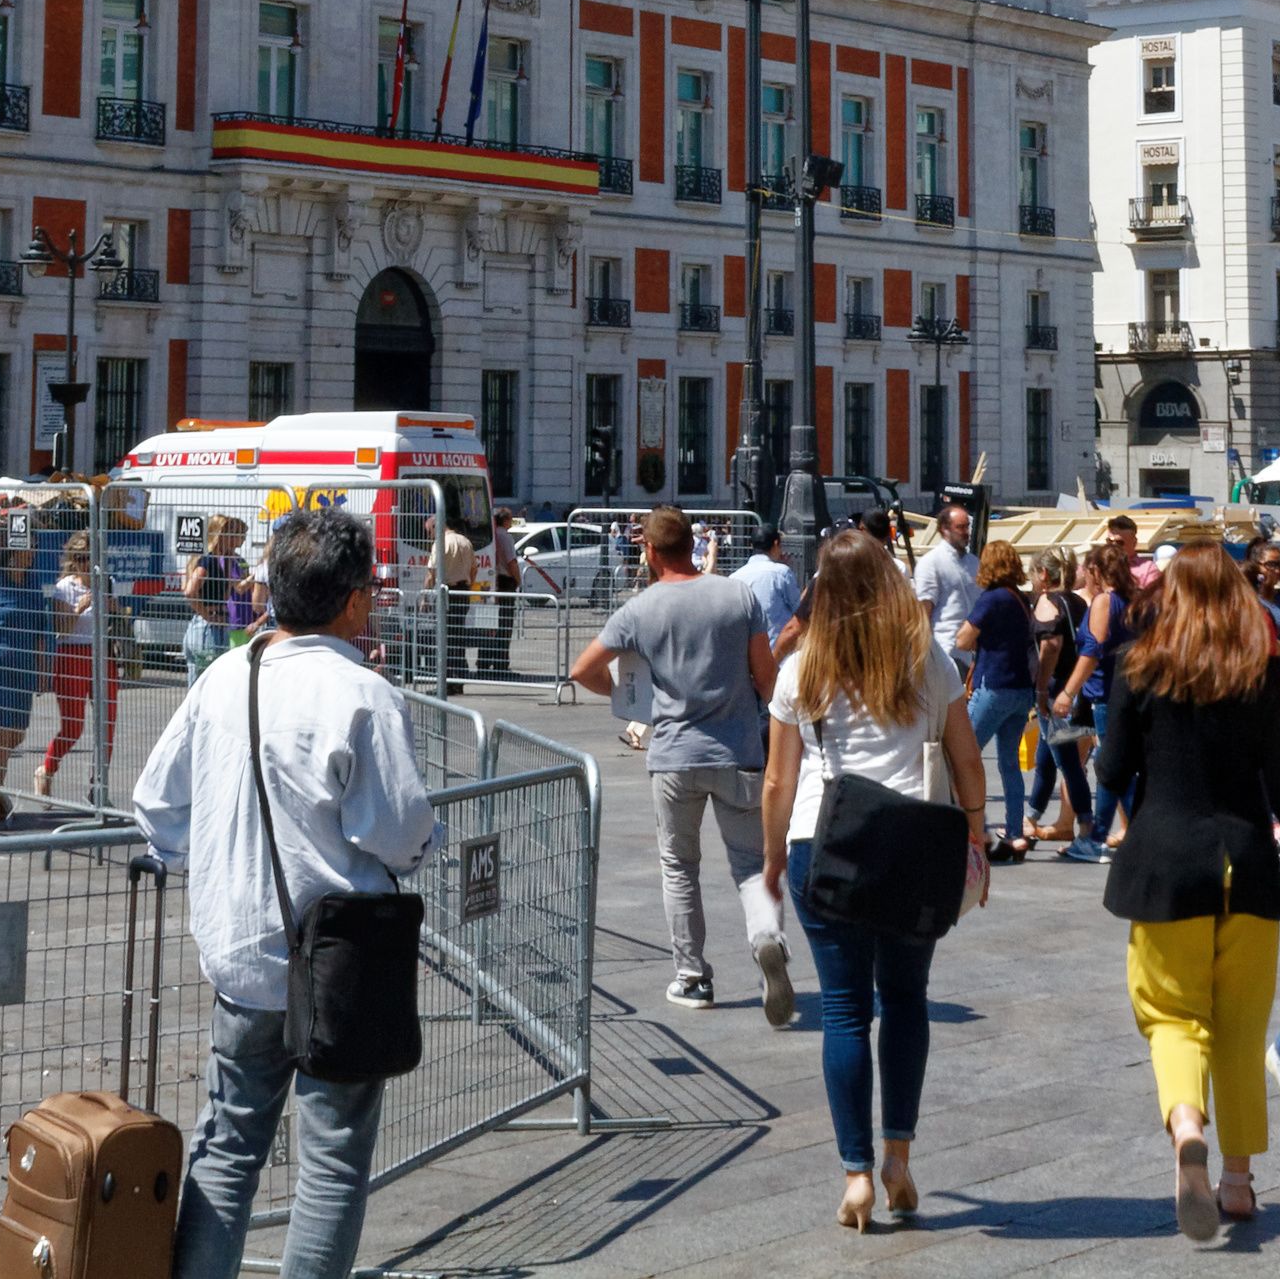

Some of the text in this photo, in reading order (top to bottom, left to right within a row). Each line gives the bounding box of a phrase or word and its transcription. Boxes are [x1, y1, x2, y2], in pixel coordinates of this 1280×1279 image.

[1156, 402, 1192, 417] BBVA
[156, 451, 234, 466] UVI MOVIL
[412, 453, 478, 468] UVI MOVIL
[11, 515, 26, 533] AMS
[180, 518, 201, 537] AMS
[470, 845, 495, 883] AMS
